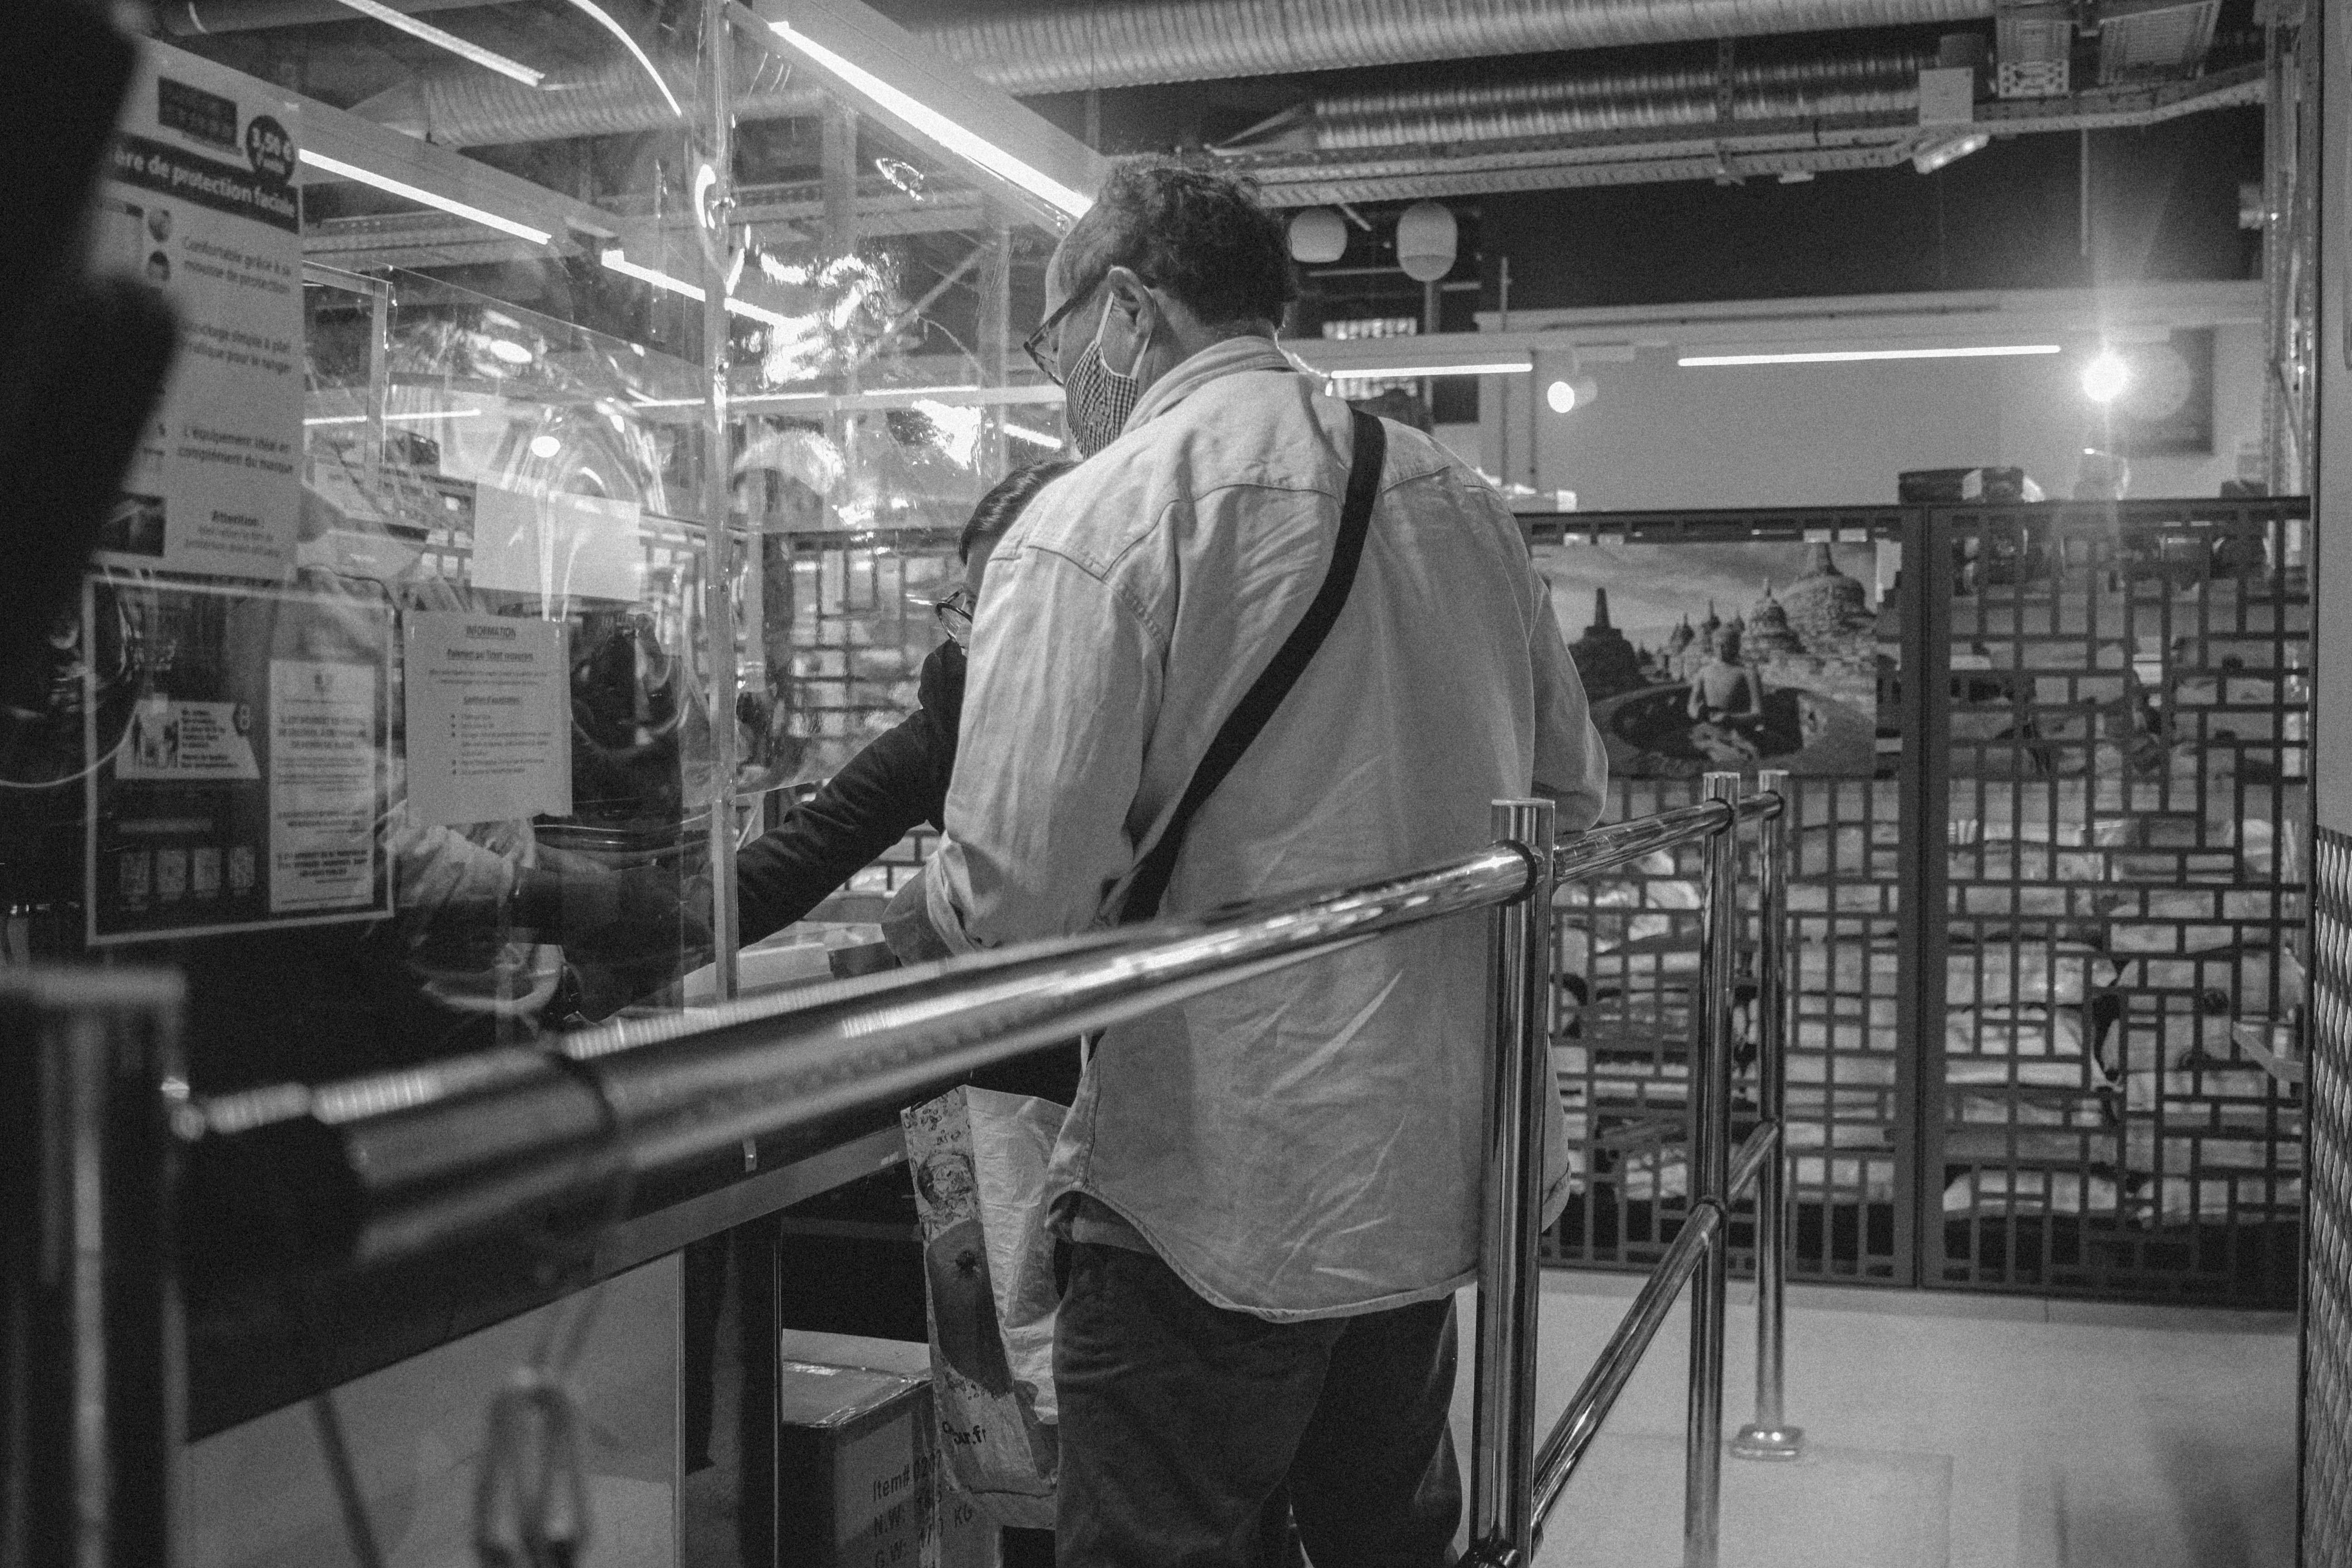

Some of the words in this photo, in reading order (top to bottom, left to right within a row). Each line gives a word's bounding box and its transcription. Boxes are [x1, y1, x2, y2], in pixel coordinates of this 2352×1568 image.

[147, 155, 169, 178] de
[172, 167, 252, 202] protection
[211, 510, 259, 527] Attention
[466, 625, 516, 639] INFORMATION
[954, 1503, 973, 1528] KG
